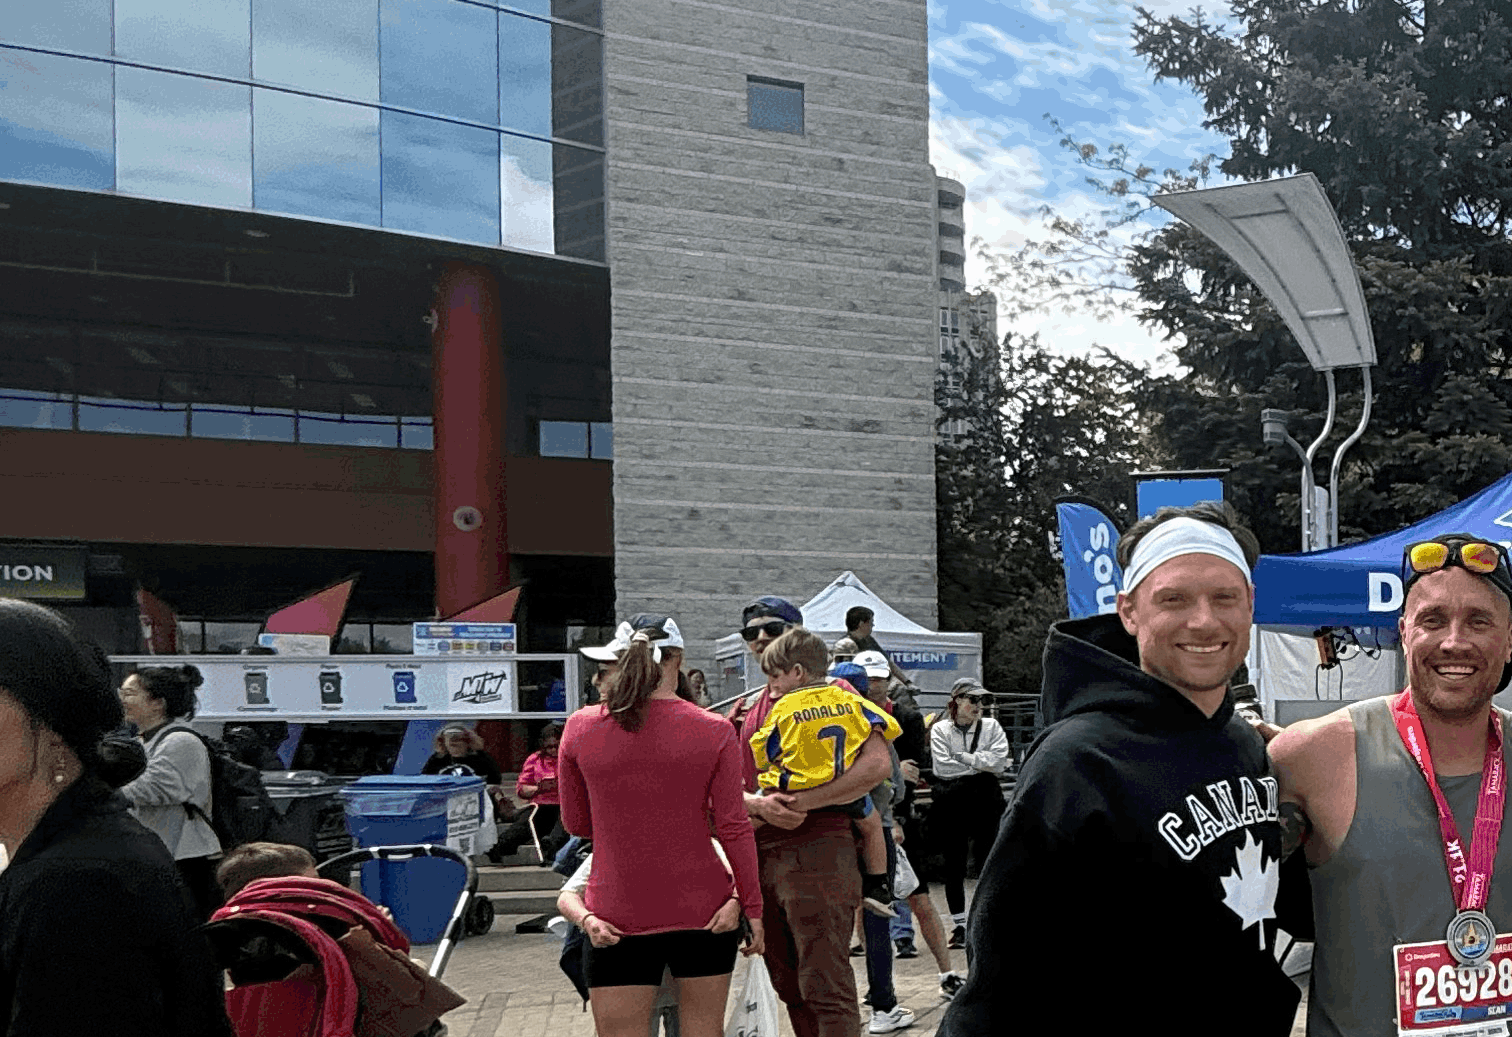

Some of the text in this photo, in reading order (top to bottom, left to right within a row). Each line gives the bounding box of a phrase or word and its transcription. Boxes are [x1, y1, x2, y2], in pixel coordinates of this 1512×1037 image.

[0, 565, 53, 581] ION
[792, 703, 854, 724] RONALDO
[817, 725, 847, 778] 7
[1446, 839, 1468, 884] 21.1K
